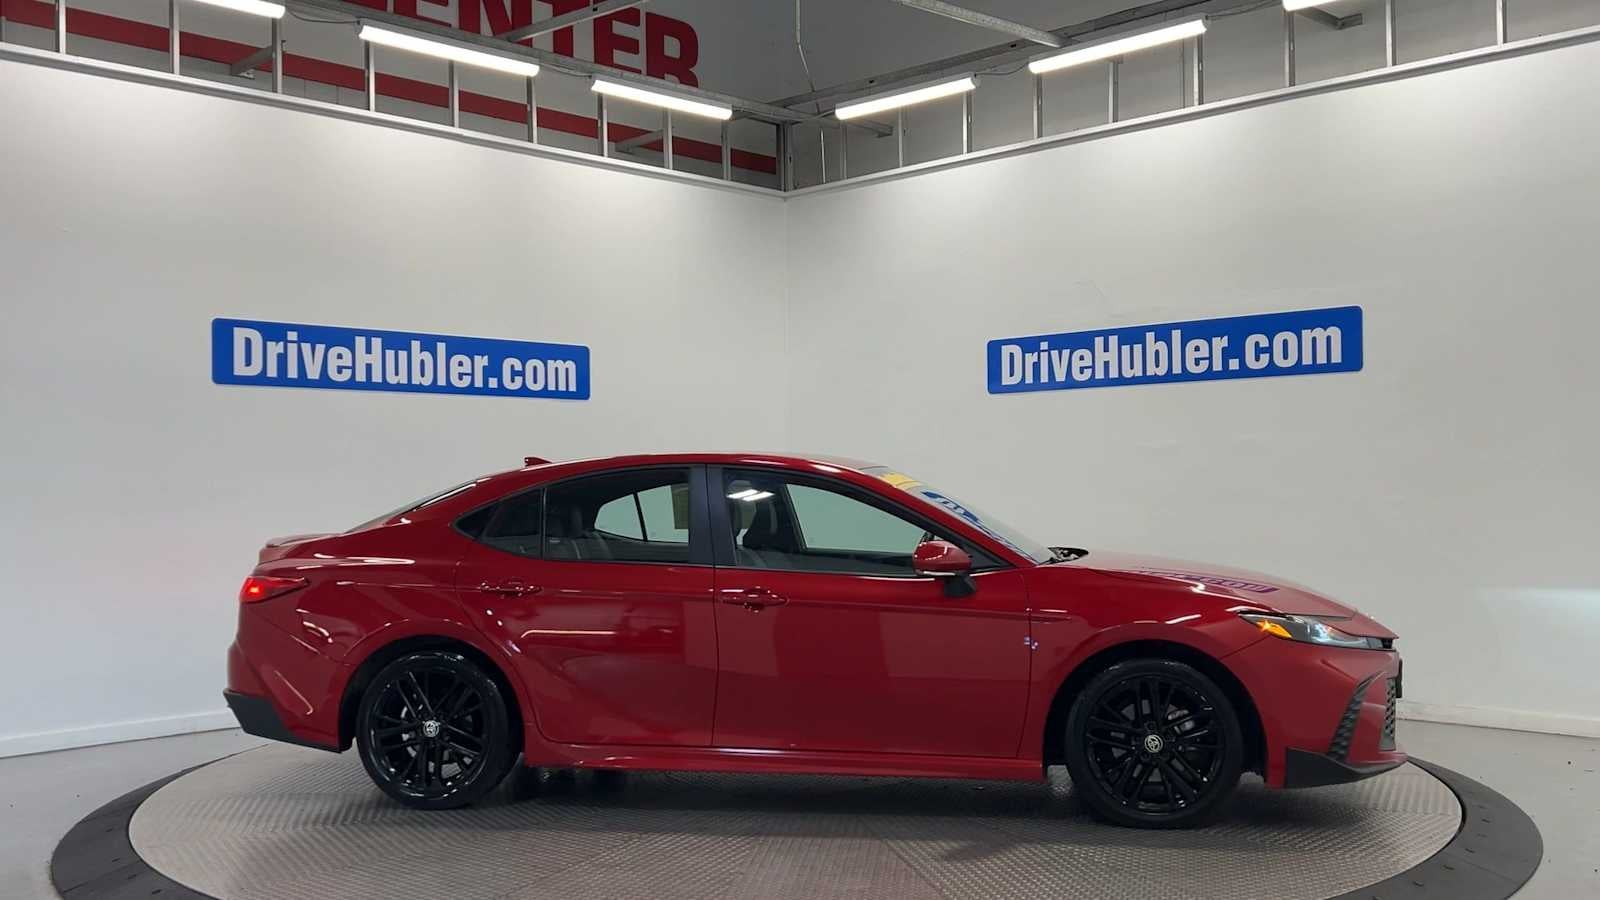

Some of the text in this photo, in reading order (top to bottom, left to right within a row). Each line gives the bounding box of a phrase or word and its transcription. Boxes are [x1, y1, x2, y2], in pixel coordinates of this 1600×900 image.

[338, 0, 698, 88] NTER
[233, 327, 576, 392] DriveHubler.com
[1001, 325, 1342, 386] DriveHubler.com
